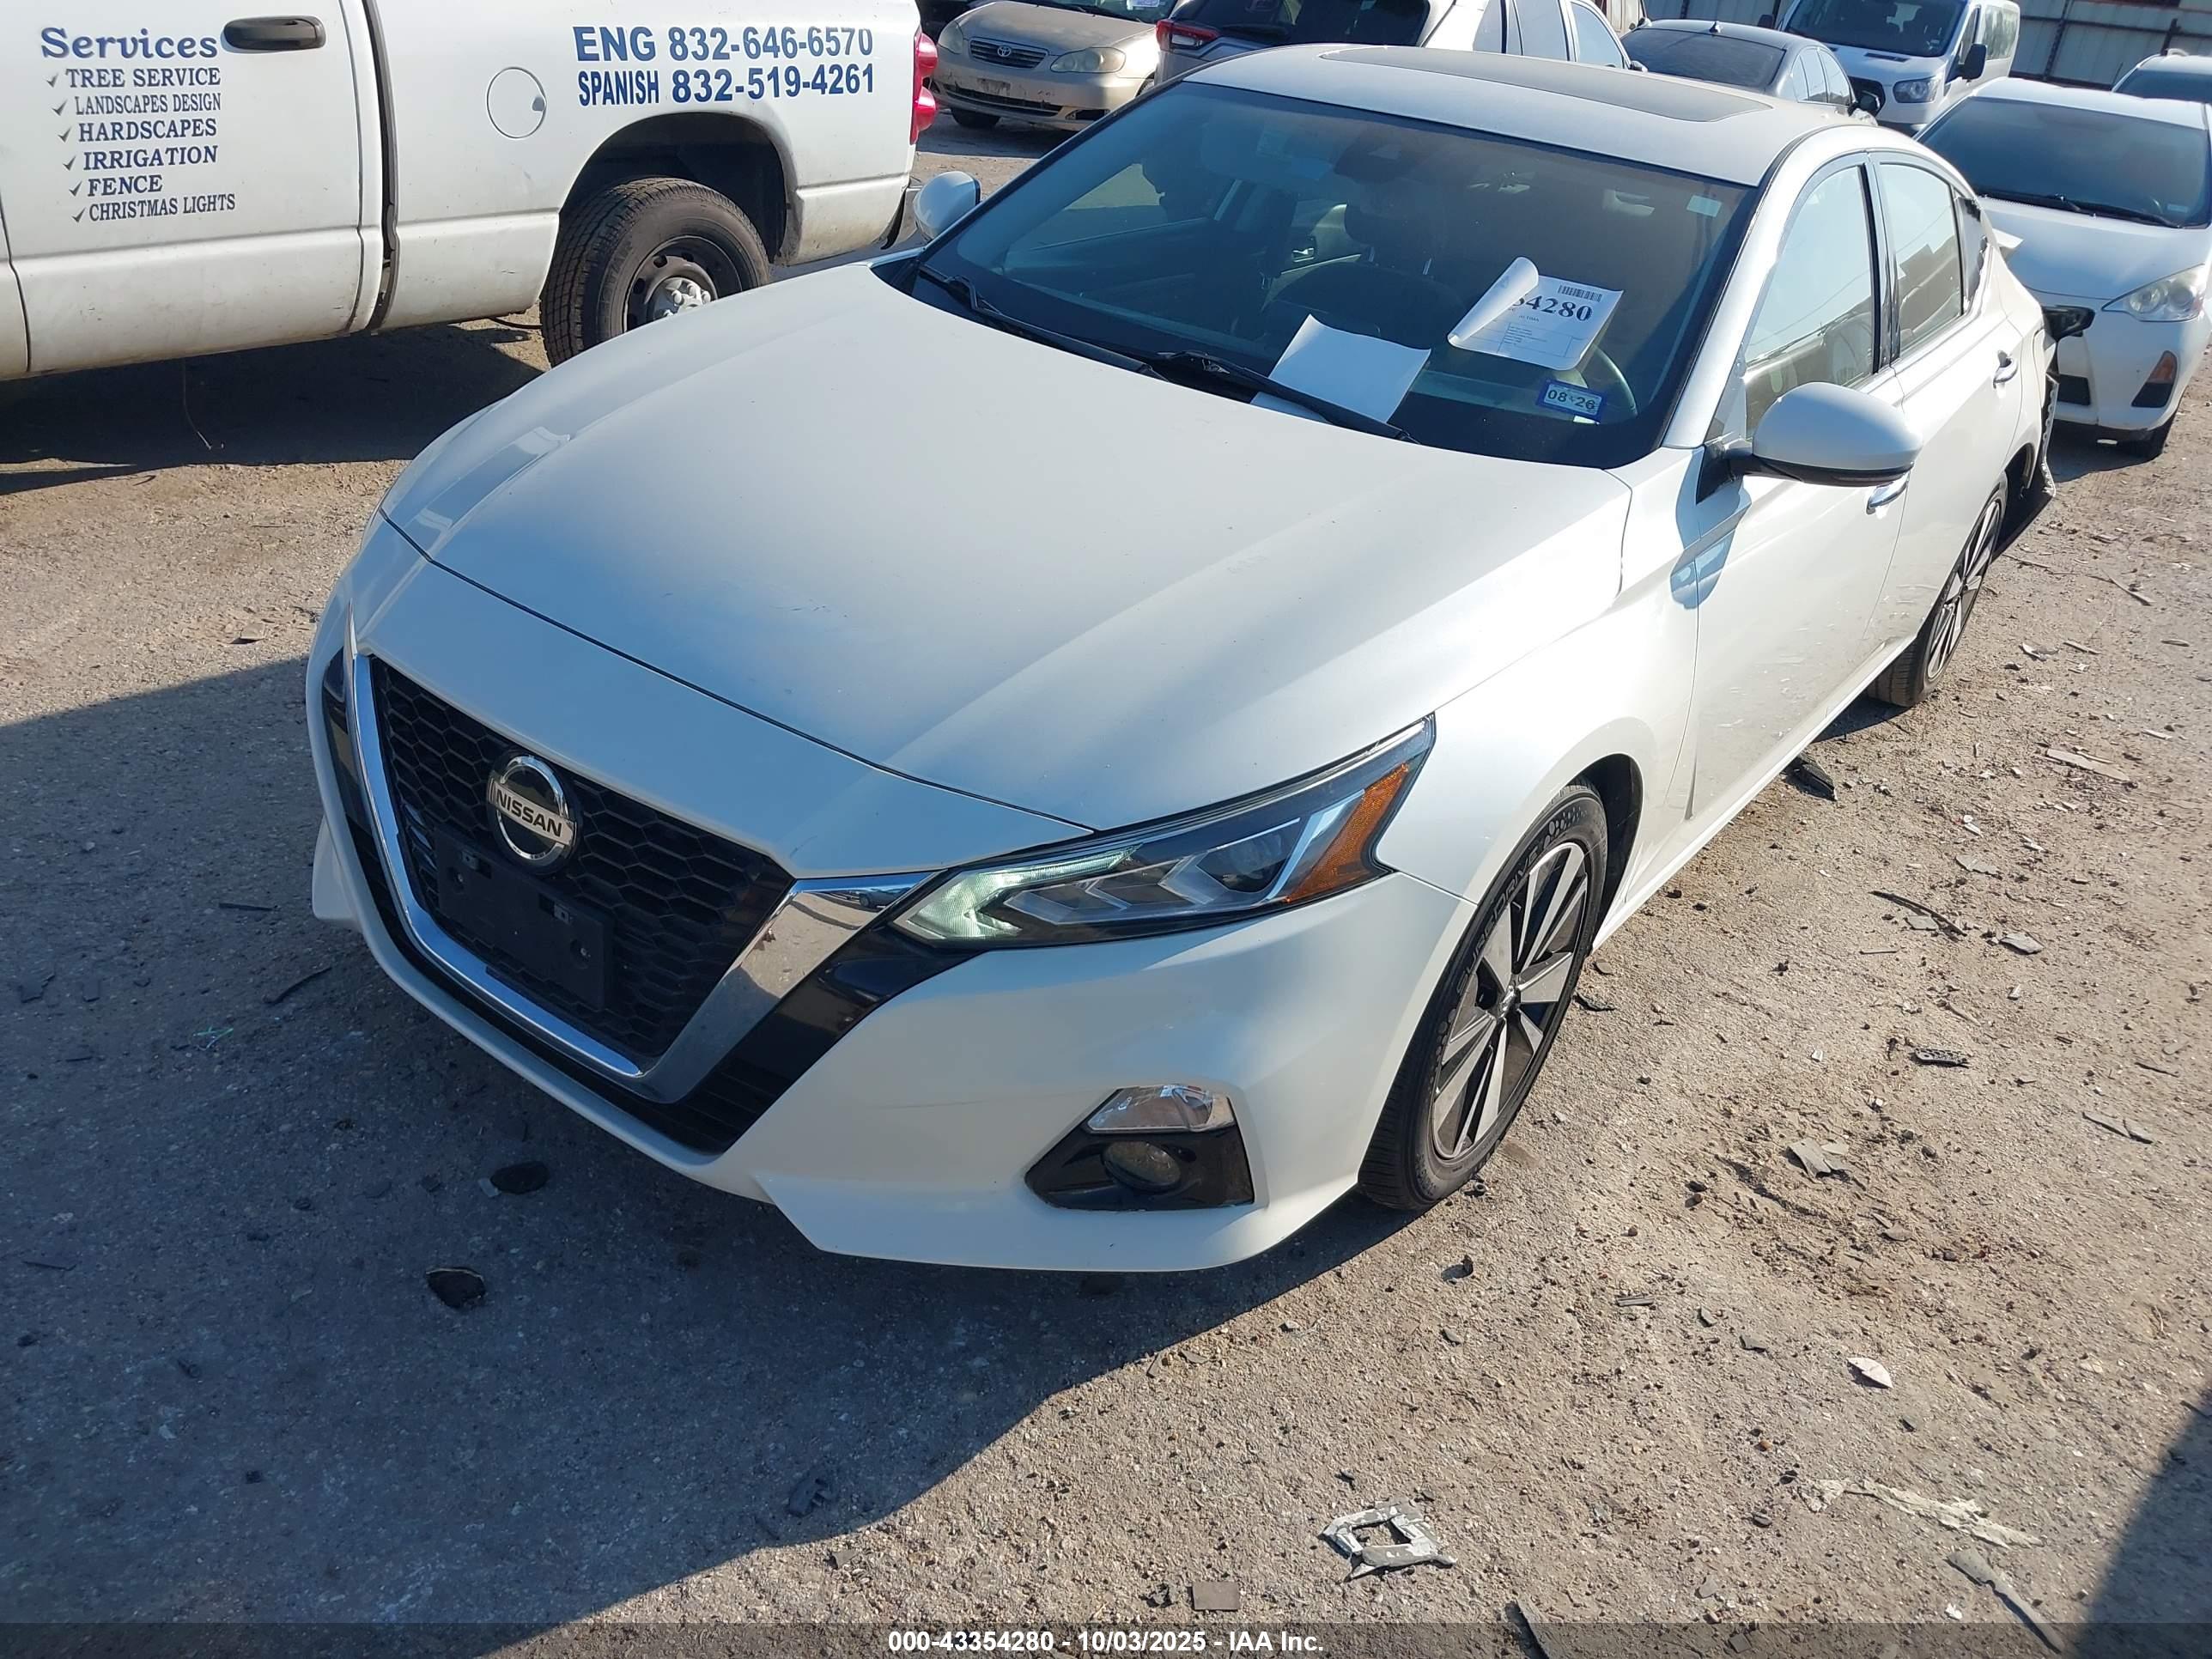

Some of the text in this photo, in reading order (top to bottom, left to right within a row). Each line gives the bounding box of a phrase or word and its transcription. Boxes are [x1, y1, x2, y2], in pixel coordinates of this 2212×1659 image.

[41, 27, 217, 58] Services
[573, 27, 873, 62] ENG 832-646-6570
[65, 67, 221, 88] TREE SERVICE
[578, 64, 873, 106] SPANISH 832-519-4261
[75, 92, 221, 116] LANDSCAPES DESIGN
[78, 118, 217, 142] HARDSCAPES
[83, 145, 218, 170] IRRIGATION
[88, 174, 163, 197] FENCE
[89, 193, 235, 222] CHRISTMAS LIGHTS
[496, 789, 562, 837] NISSAN
